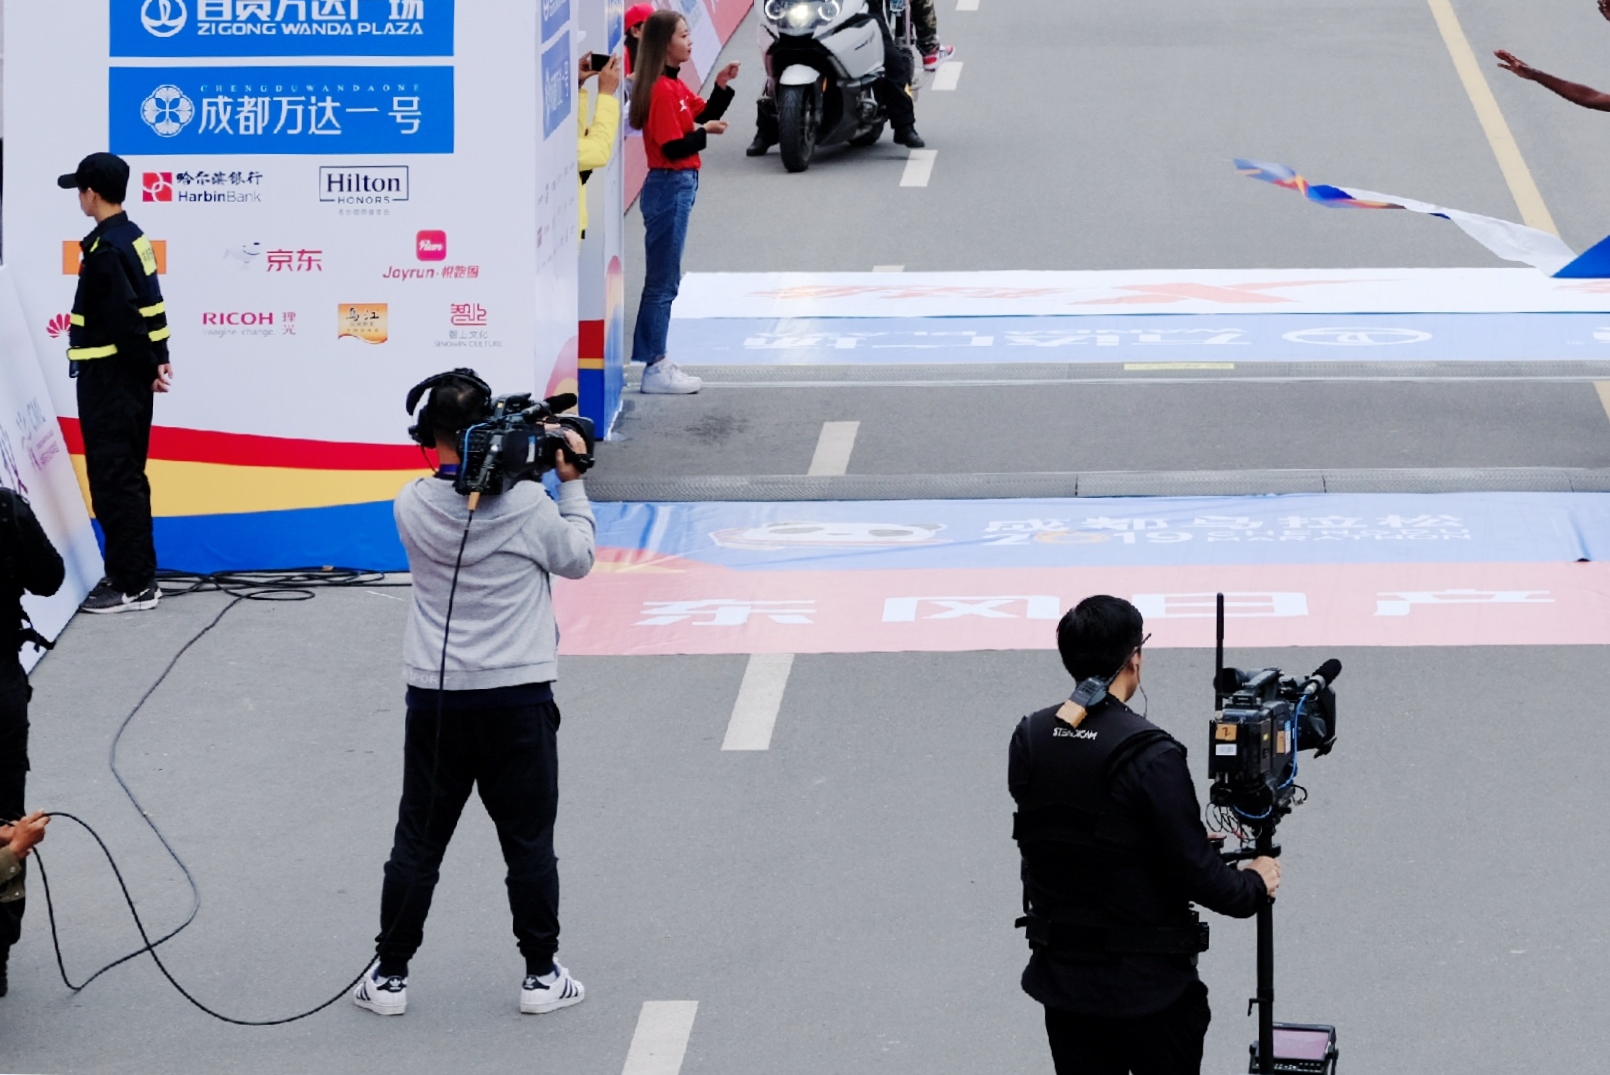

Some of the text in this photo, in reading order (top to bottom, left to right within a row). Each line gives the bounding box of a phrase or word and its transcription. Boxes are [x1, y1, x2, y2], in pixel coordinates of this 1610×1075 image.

[197, 22, 424, 36] ZIGONG WANDA PLAZA
[198, 95, 423, 138] 成都万达一号
[326, 172, 402, 194] Hilton
[178, 189, 262, 204] HarbinBank
[337, 195, 391, 205] HONORS
[266, 248, 323, 273] 京东
[202, 312, 274, 325] RICOH
[641, 587, 1556, 627] 东风日产
